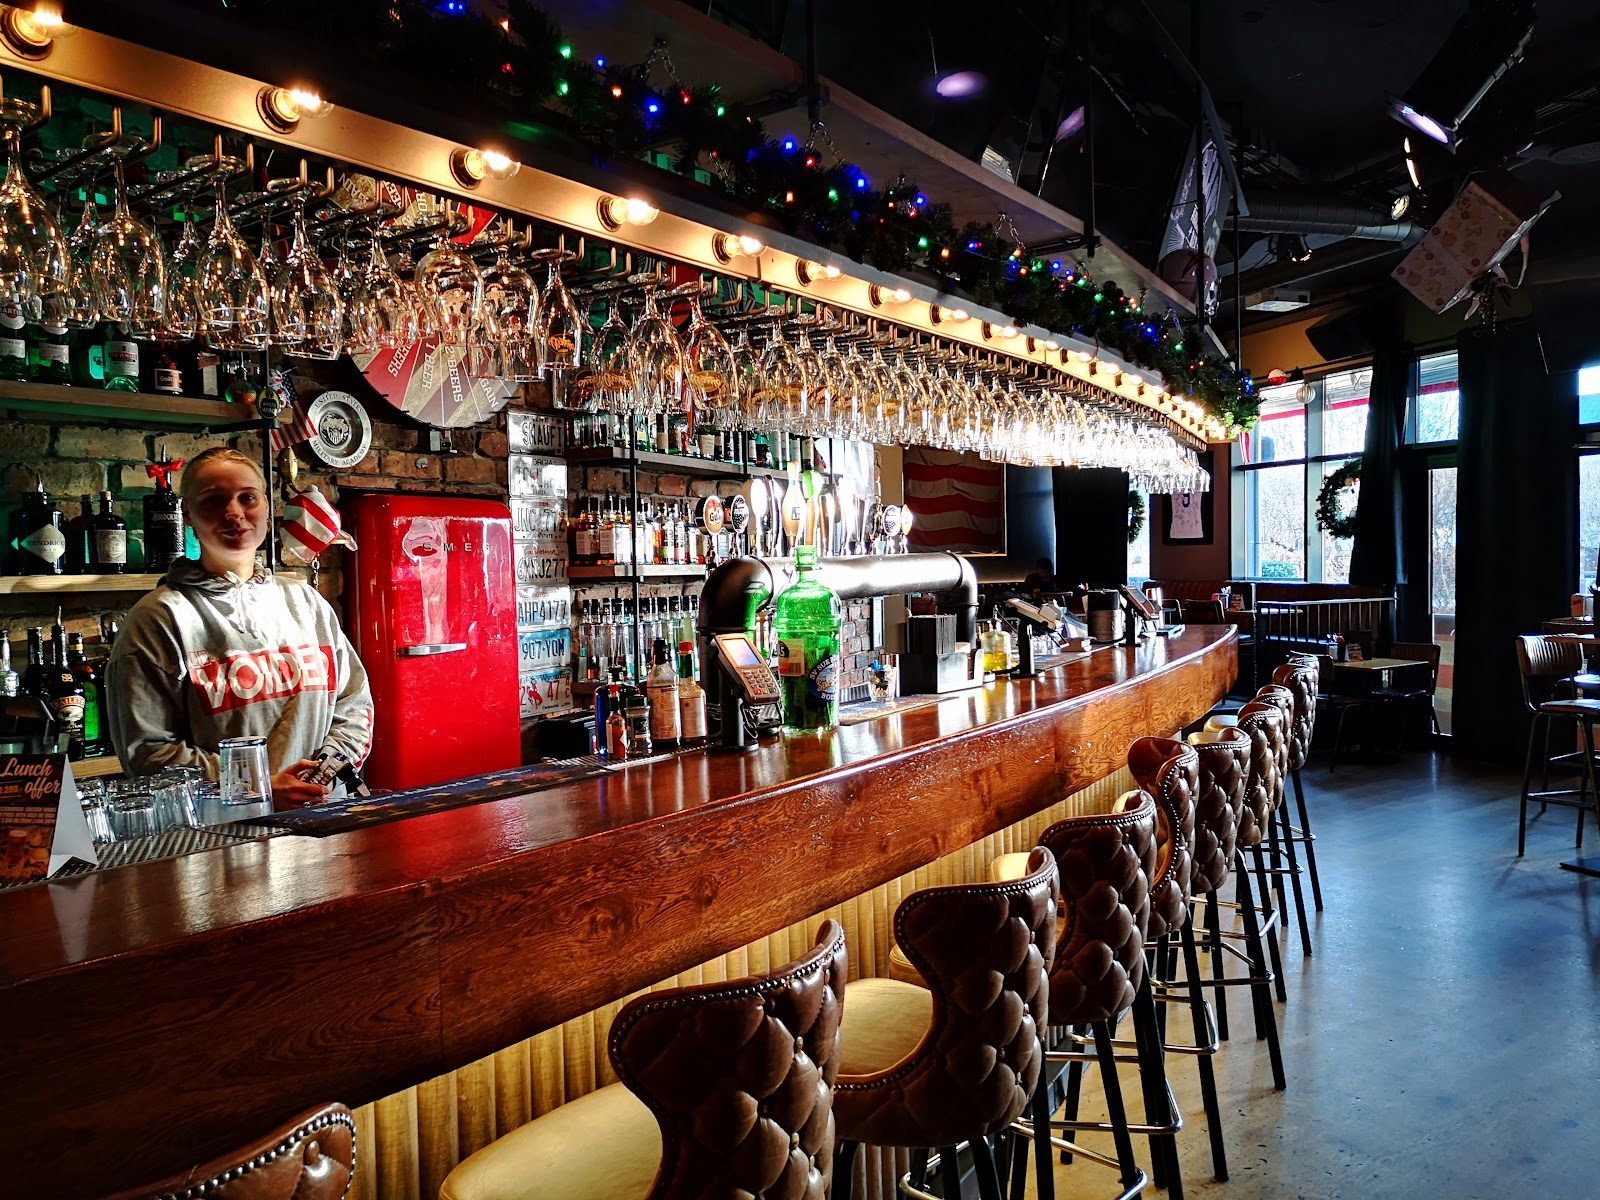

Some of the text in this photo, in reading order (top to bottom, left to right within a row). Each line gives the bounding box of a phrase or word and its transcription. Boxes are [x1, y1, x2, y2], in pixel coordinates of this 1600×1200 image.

[421, 352, 435, 390] BEER
[448, 358, 464, 403] BEERS
[0, 757, 52, 777] Lunch
[24, 777, 61, 799] offer
